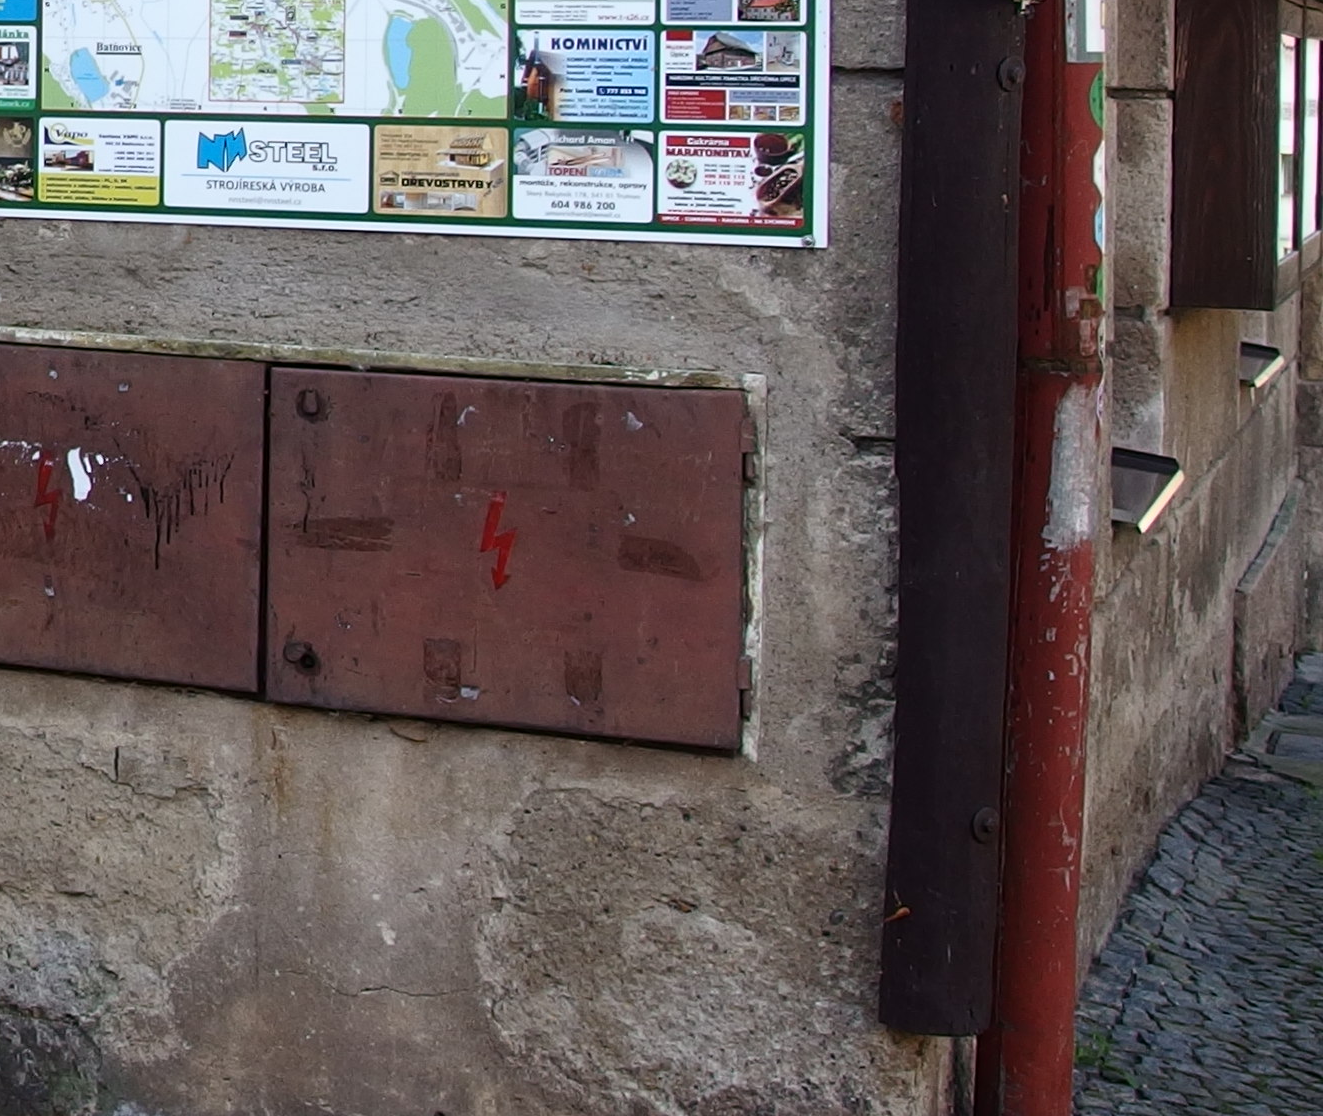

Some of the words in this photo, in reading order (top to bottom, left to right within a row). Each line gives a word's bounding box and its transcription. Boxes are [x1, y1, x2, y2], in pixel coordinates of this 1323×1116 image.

[96, 42, 142, 53] Batňovice
[551, 35, 648, 50] KOMINICTVÍ
[587, 136, 615, 144] Aman
[687, 137, 729, 146] Cukrárna
[249, 140, 337, 164] STEEL
[548, 165, 587, 176] TOPENÍ
[206, 180, 276, 191] STROJÍRESKÁ
[280, 181, 326, 192] VÝROBA
